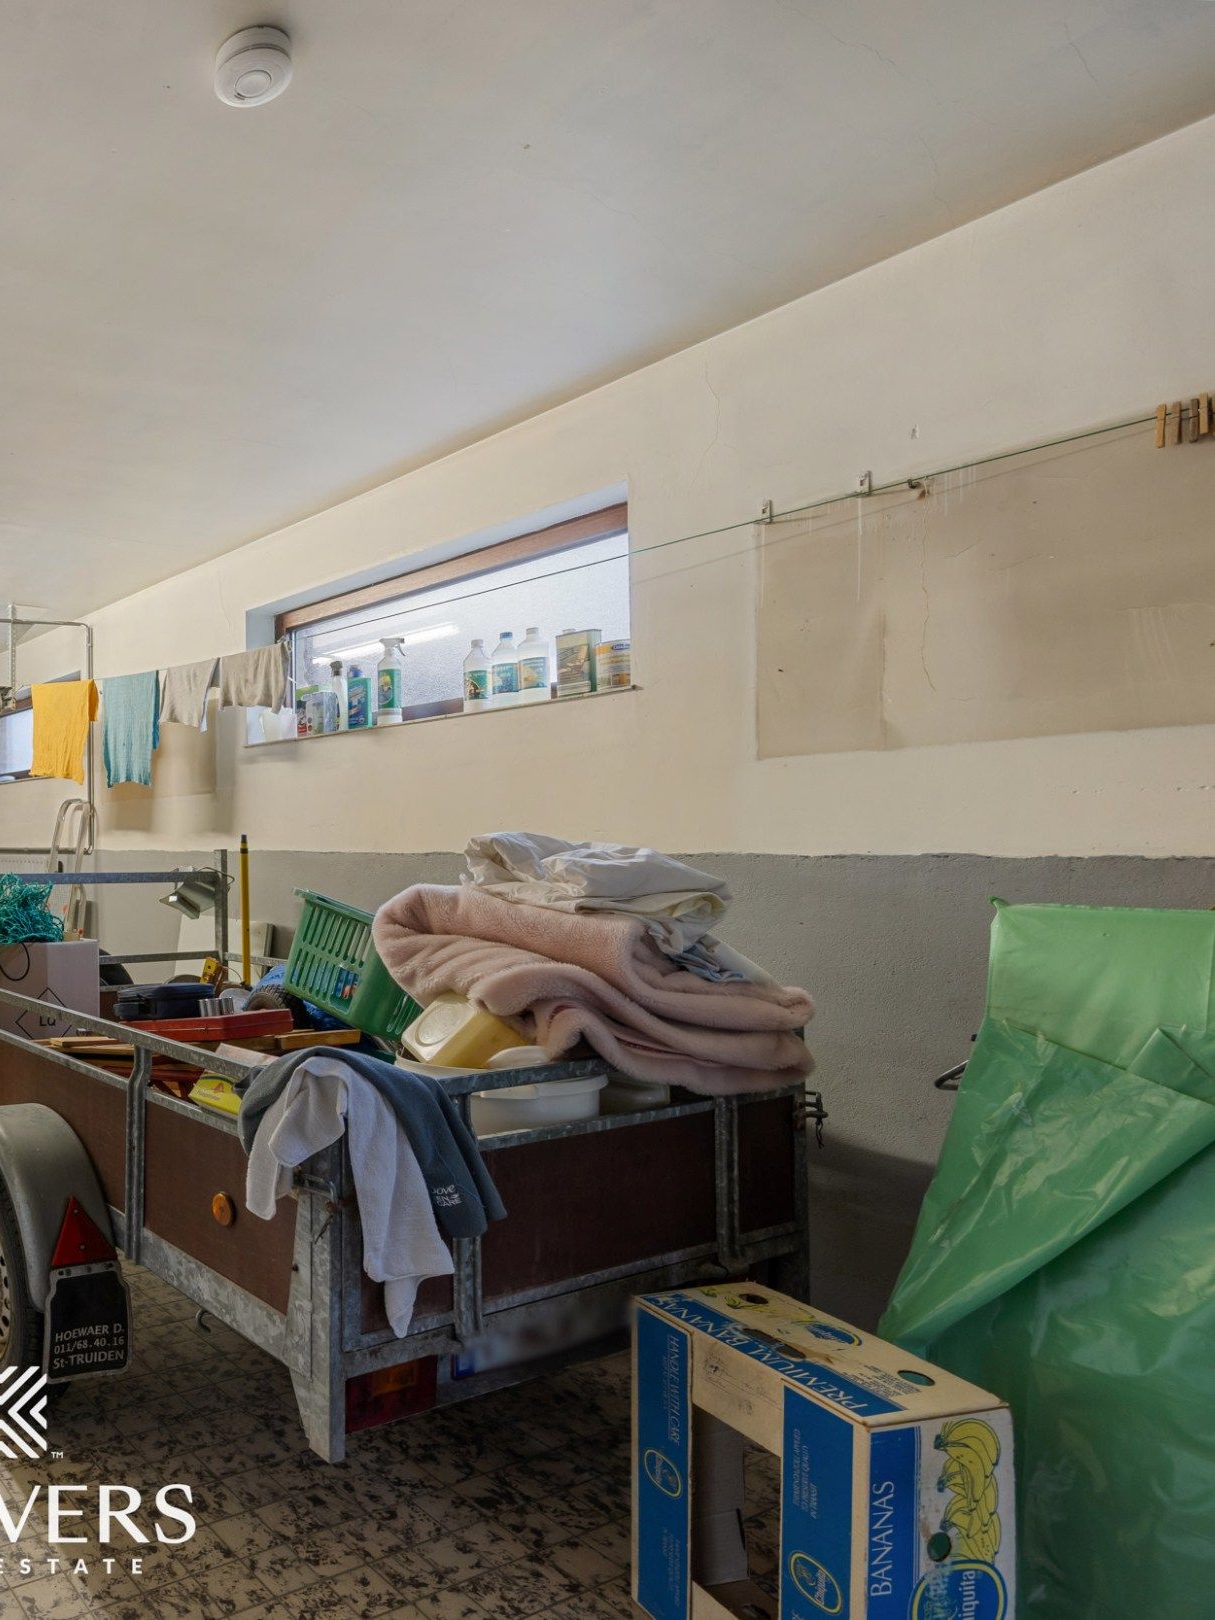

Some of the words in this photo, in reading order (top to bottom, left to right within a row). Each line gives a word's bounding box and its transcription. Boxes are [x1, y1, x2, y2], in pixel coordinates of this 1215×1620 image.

[55, 1324, 110, 1342] HOEWAER
[649, 1293, 750, 1347] BANANAS
[754, 1343, 869, 1411] PREMIUM
[871, 1480, 895, 1597] BANANAS
[959, 1570, 980, 1620] iquita
